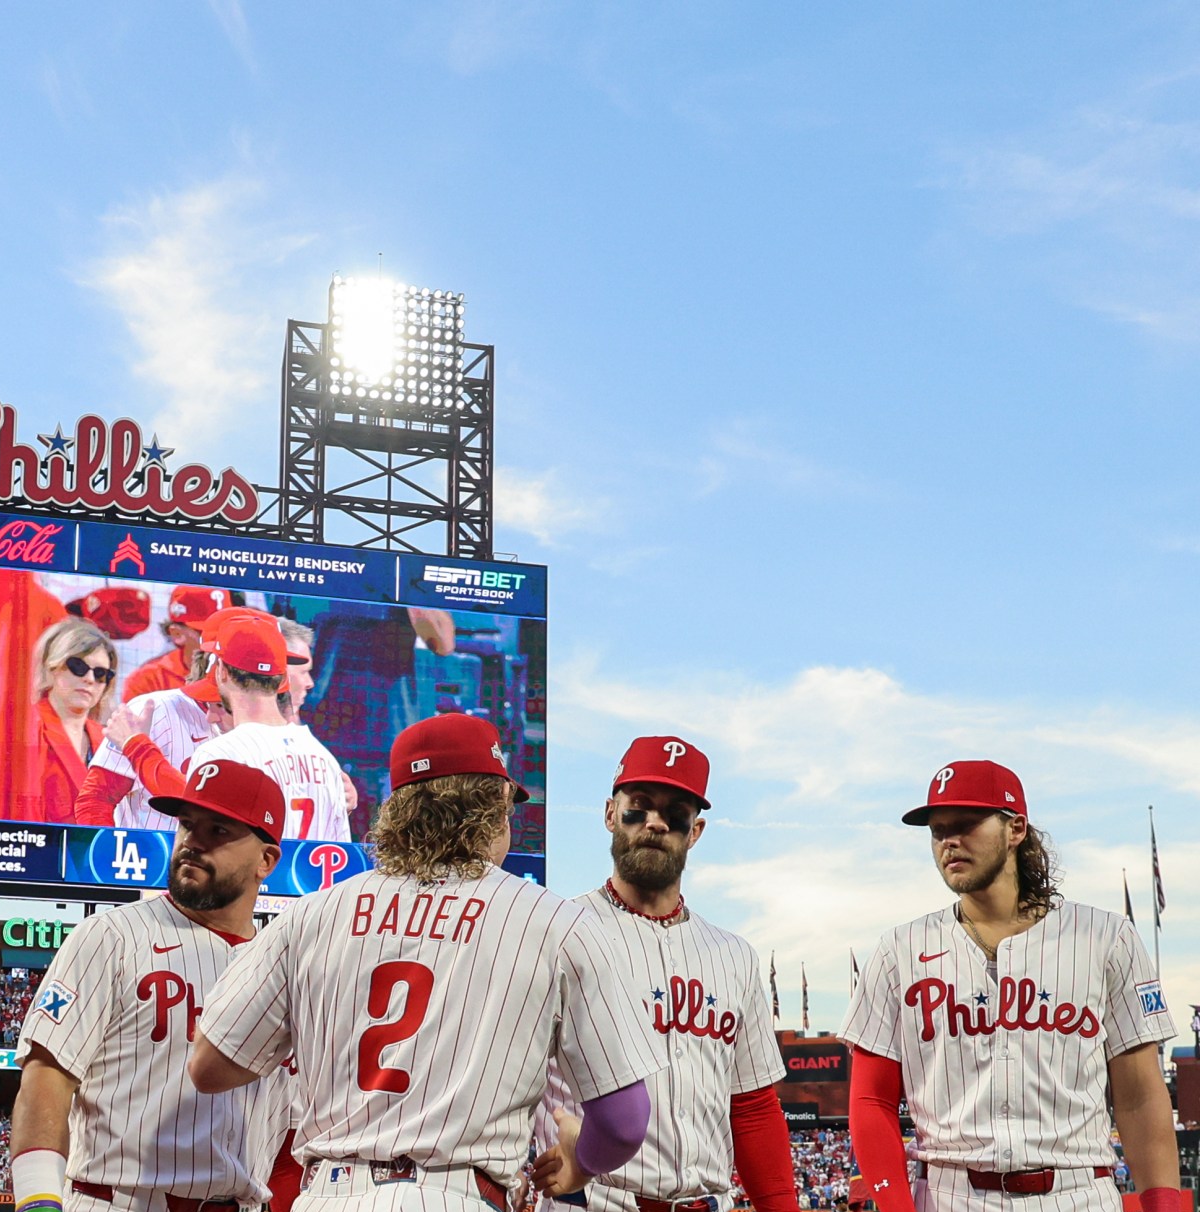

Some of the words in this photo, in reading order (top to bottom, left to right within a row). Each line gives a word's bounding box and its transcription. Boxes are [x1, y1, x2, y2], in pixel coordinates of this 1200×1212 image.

[150, 542, 192, 558] SALTZ
[198, 547, 289, 568] MONGELUZZI
[294, 556, 366, 574] BENDESKY
[192, 562, 248, 578] INJURY
[258, 569, 325, 585] LAWYERS
[434, 584, 514, 600] SPORTSBOOK
[663, 741, 686, 767] P
[198, 763, 220, 791] P
[936, 767, 955, 794] P
[111, 830, 148, 881] LA
[309, 844, 348, 891] P
[351, 893, 486, 945] BADER
[904, 976, 1100, 1042] Phillies
[1140, 990, 1166, 1014] IBX
[357, 960, 436, 1095] 2
[788, 1056, 842, 1070] GIANT
[784, 1112, 817, 1121] Fanatics
